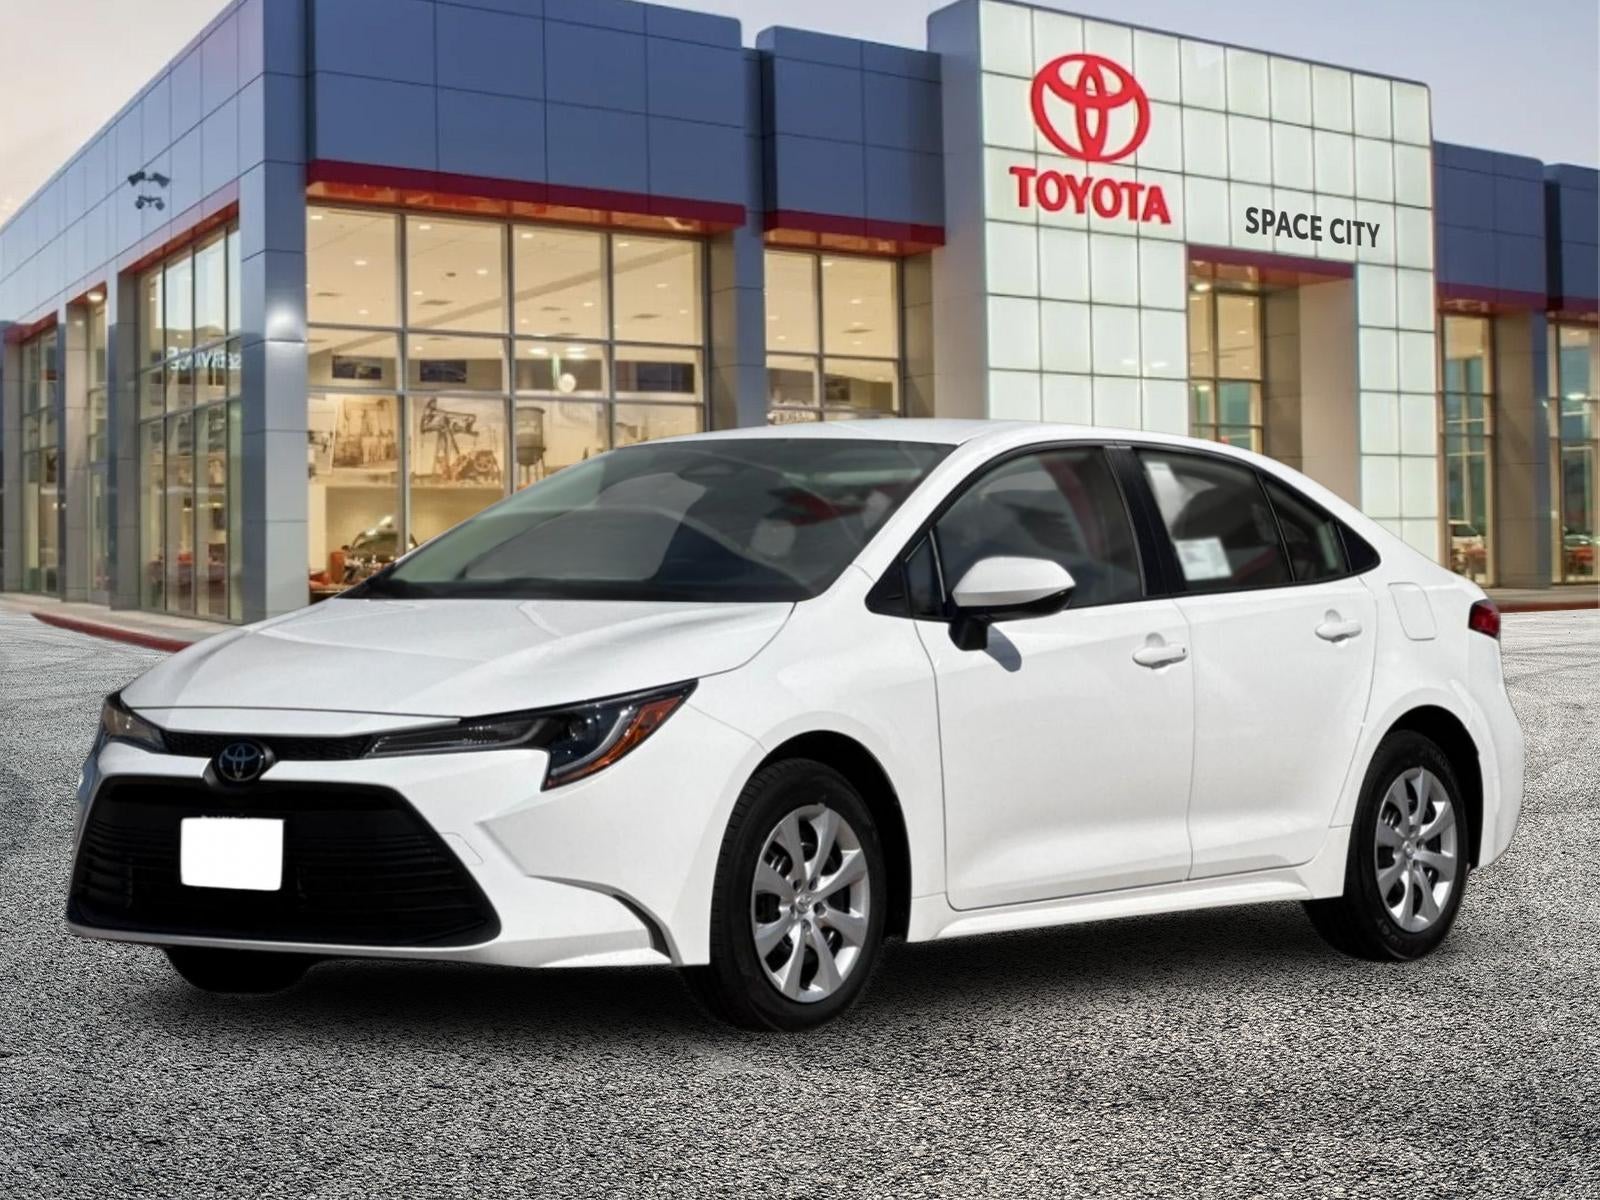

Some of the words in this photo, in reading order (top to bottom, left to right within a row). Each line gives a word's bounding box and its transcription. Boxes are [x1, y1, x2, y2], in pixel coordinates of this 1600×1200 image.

[1009, 166, 1171, 224] TOYOTA
[1245, 206, 1323, 242] SPACE
[1329, 217, 1381, 248] CITY
